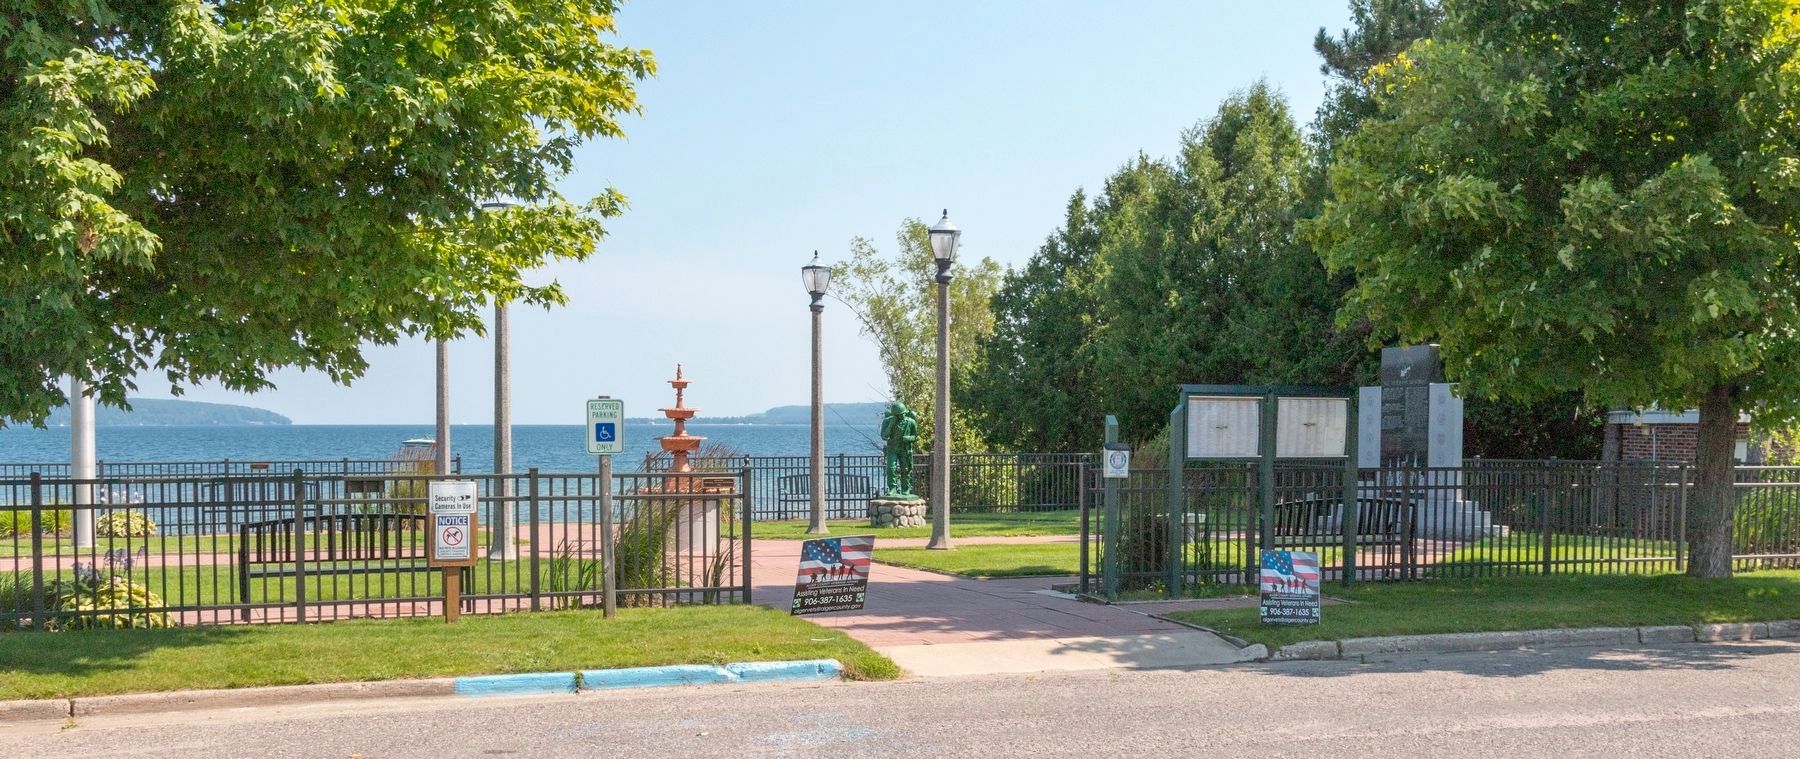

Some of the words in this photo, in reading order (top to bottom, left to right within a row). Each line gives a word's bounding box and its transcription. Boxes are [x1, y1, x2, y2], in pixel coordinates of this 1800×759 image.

[592, 411, 618, 419] PARKING
[439, 517, 467, 525] NOTICE
[819, 587, 843, 595] Veterans
[804, 595, 853, 606] 906-387-1635
[1269, 608, 1310, 616] 906-387-1635
